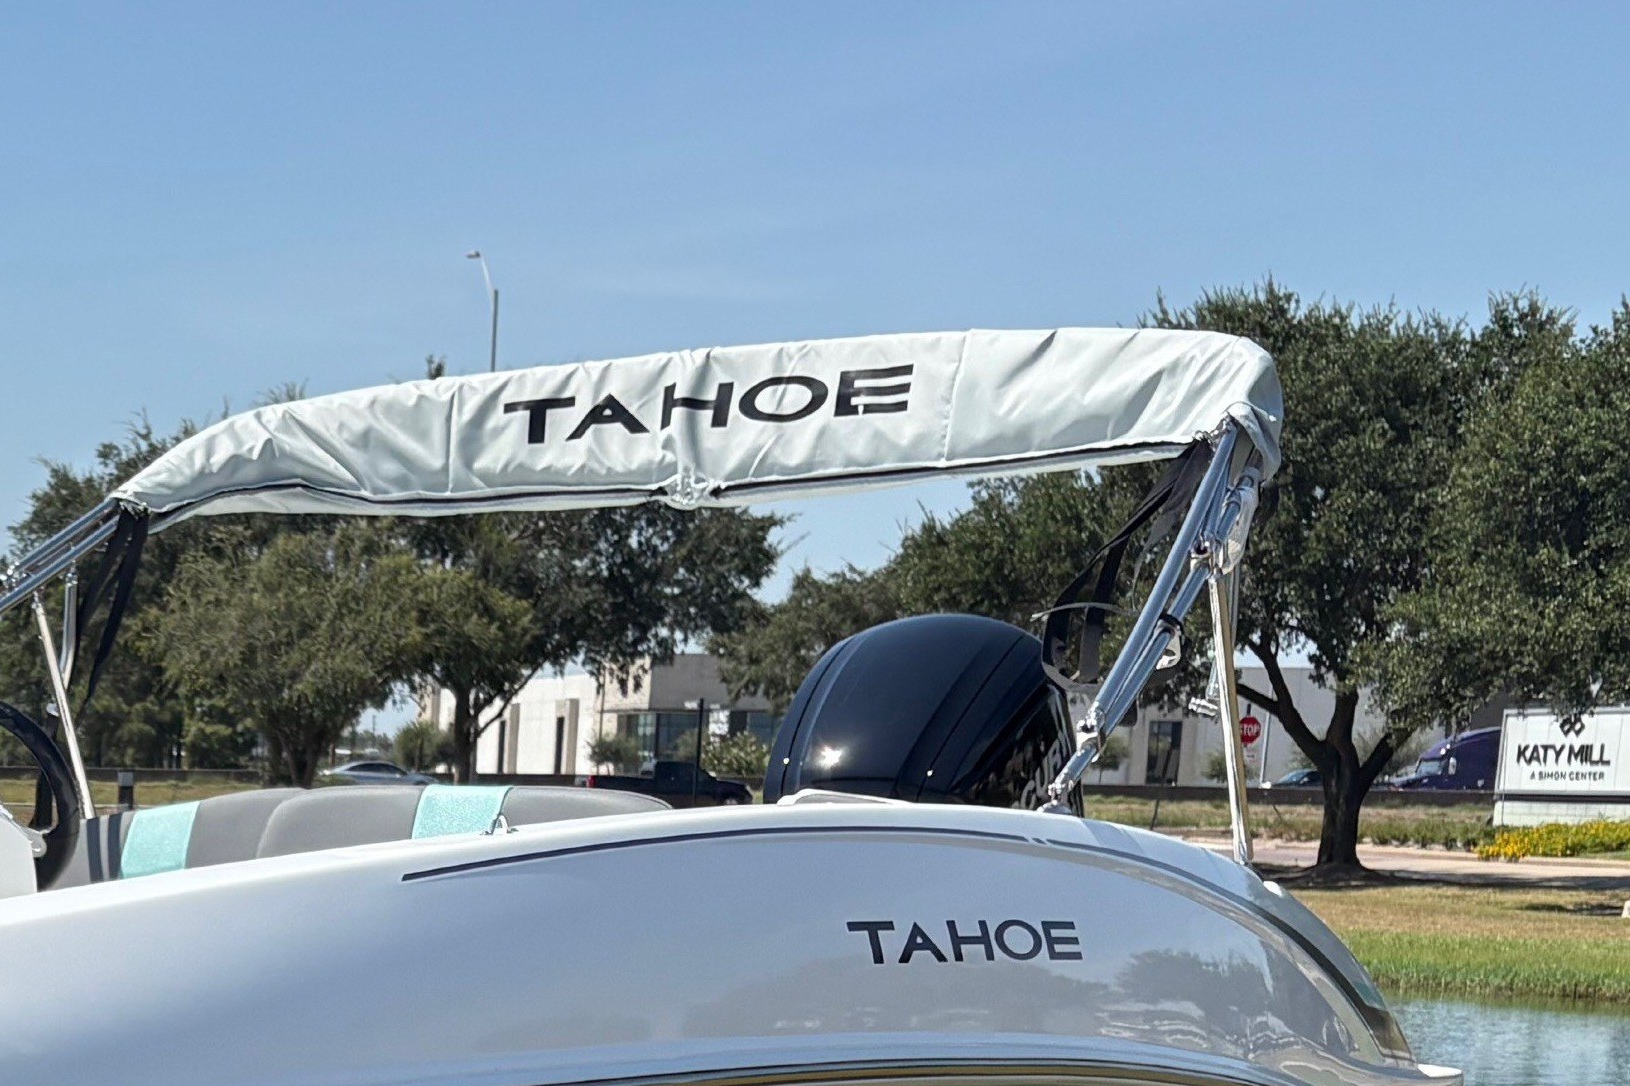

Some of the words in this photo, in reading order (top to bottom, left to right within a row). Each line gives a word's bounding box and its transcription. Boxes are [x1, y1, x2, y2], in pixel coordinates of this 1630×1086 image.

[503, 363, 914, 445] TAHOE
[1516, 744, 1566, 766] KATY
[1567, 743, 1611, 767] MILL
[1530, 771, 1536, 780] A
[1538, 771, 1567, 781] SIMON
[1568, 771, 1605, 781] CENTER
[846, 919, 1083, 964] TAHOE
